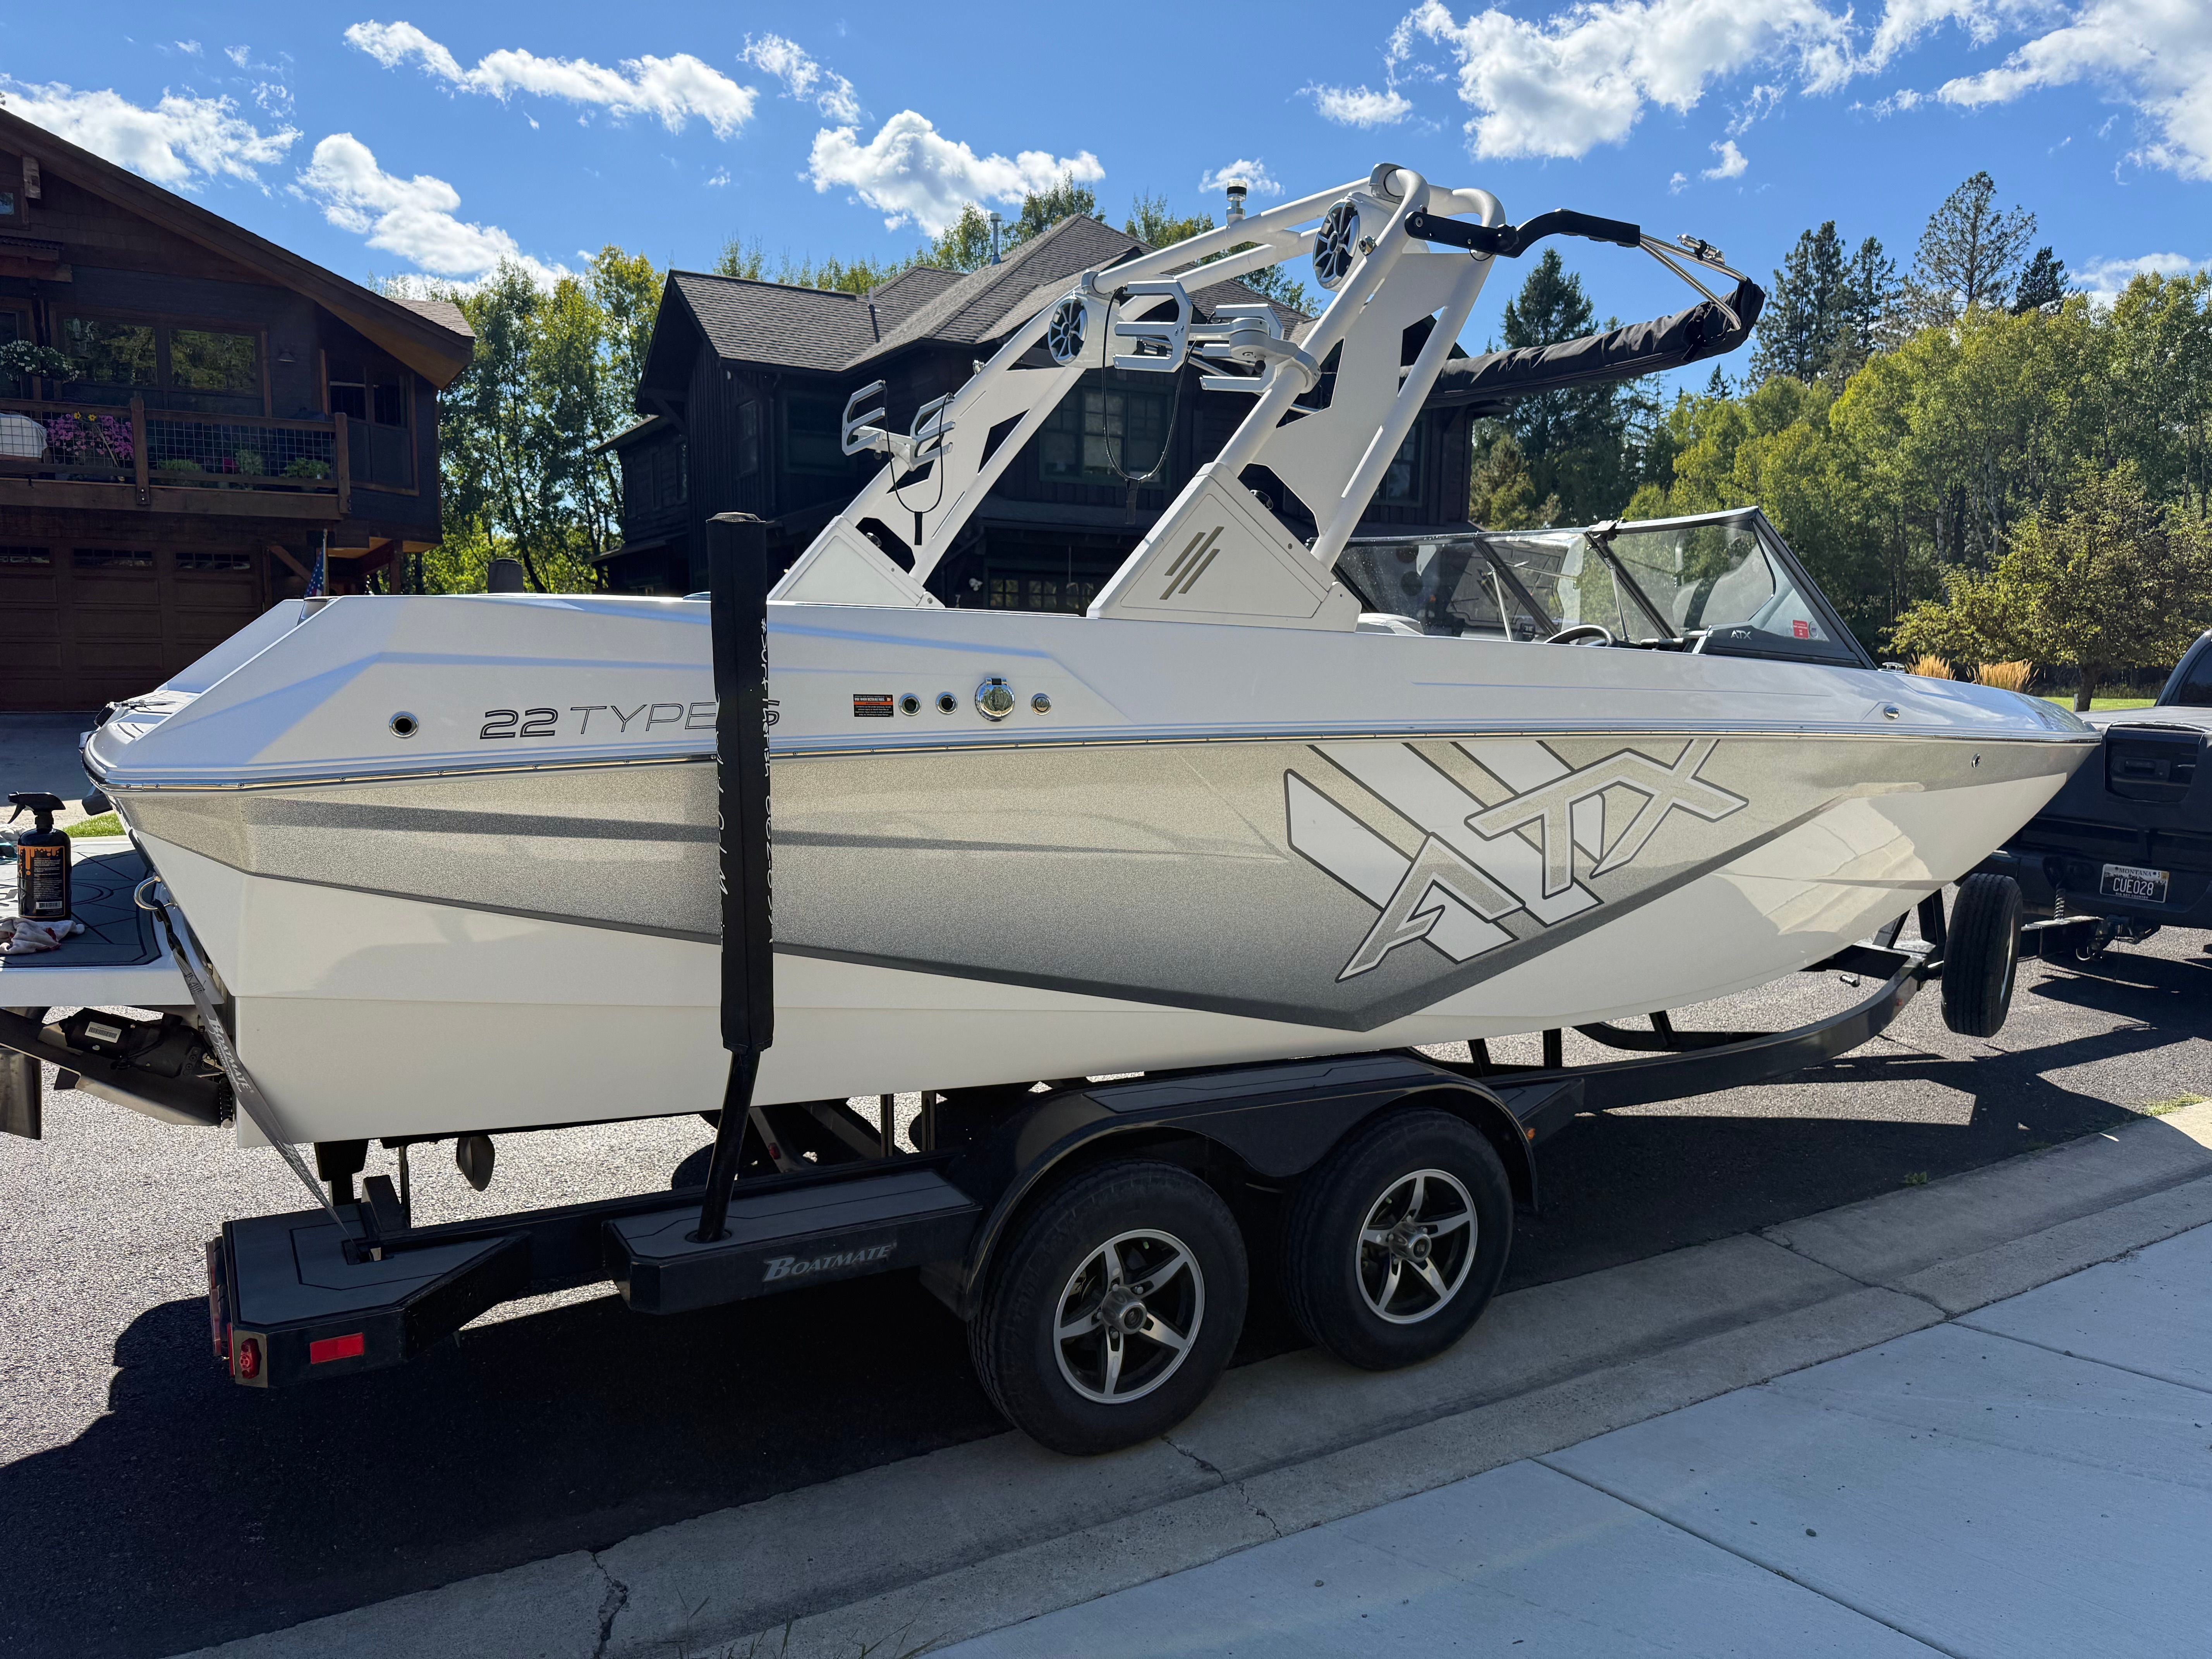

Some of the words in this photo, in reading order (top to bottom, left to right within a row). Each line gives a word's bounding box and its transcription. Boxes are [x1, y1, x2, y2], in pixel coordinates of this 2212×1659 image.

[1731, 630, 1752, 640] ATX
[479, 708, 558, 740] 22
[1334, 738, 1749, 983] ATX
[2119, 867, 2152, 877] MONTANA
[2113, 878, 2154, 896] CUE028
[208, 1015, 252, 1090] BOATMATE
[763, 1245, 891, 1282] BOATMATE
